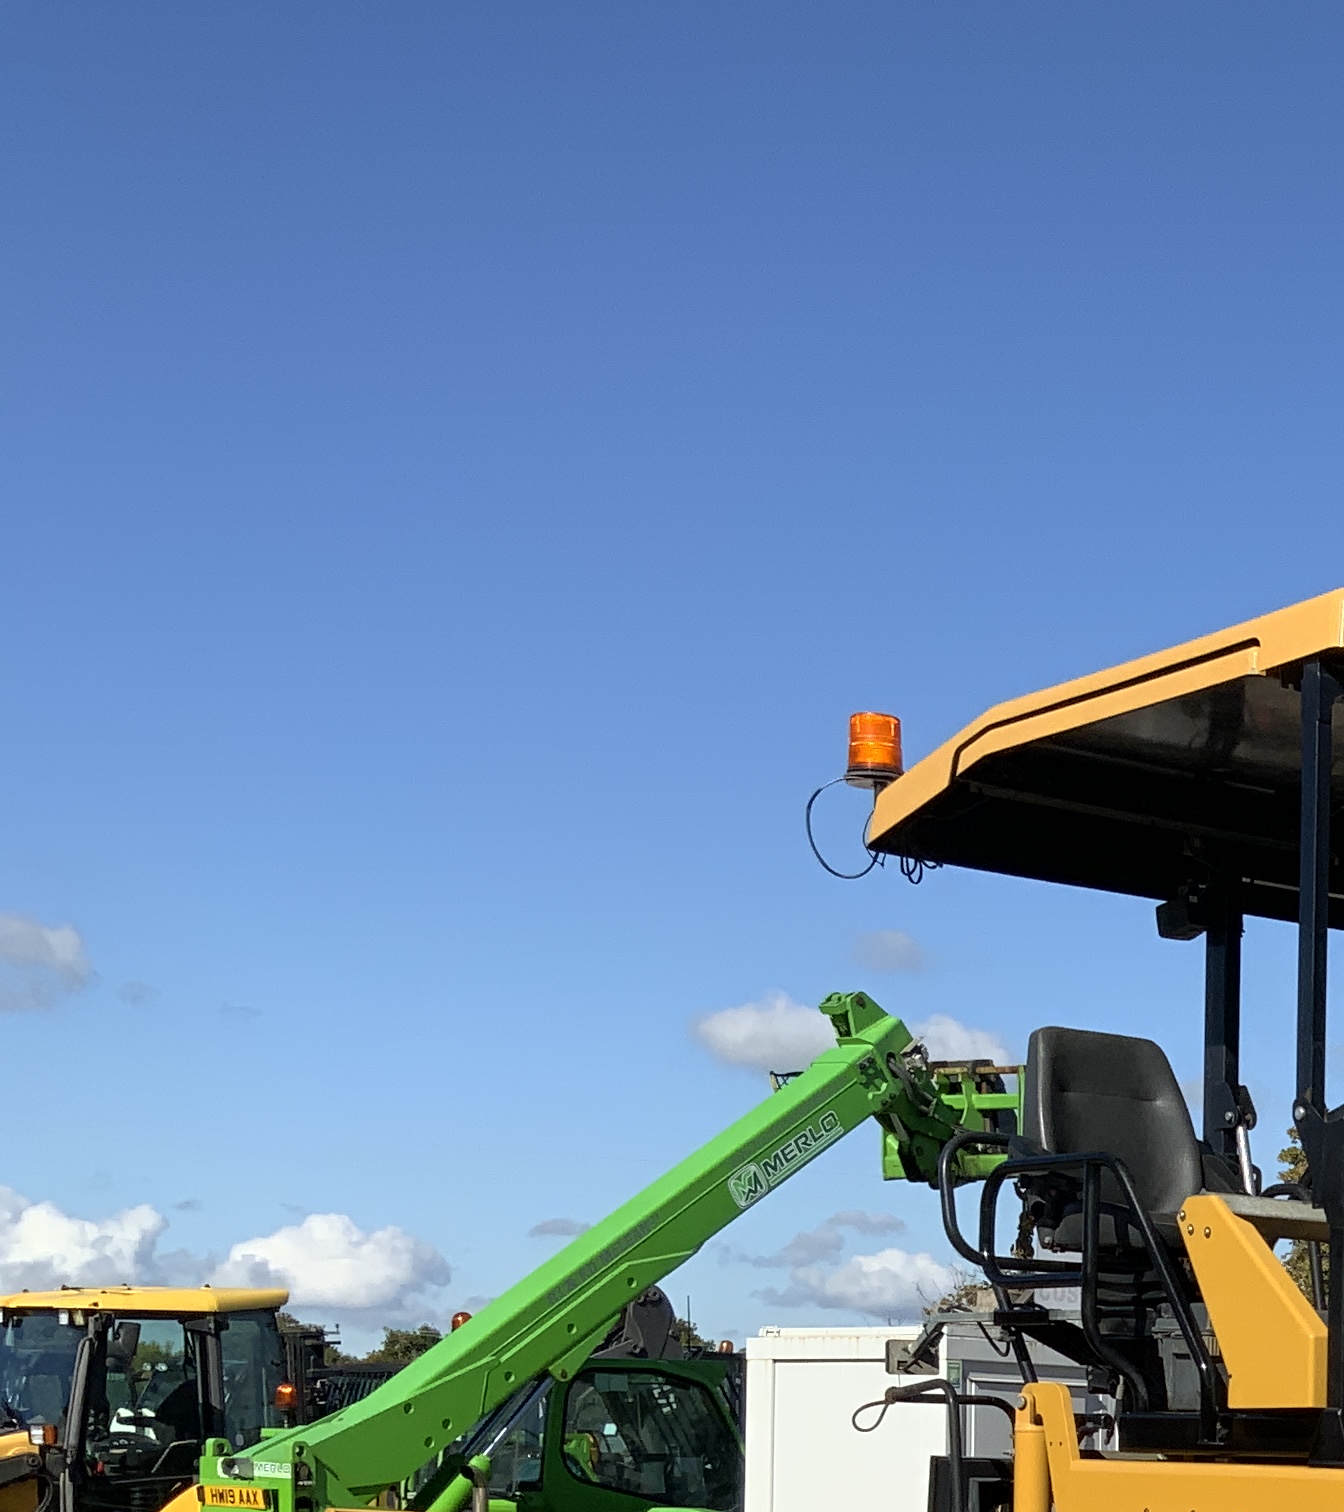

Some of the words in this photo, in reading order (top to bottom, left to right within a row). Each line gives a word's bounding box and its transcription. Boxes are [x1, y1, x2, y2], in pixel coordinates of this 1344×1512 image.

[762, 1111, 840, 1178] MERLO
[254, 1462, 291, 1474] MERLO
[210, 1487, 236, 1505] HW19
[238, 1489, 260, 1506] AAX
